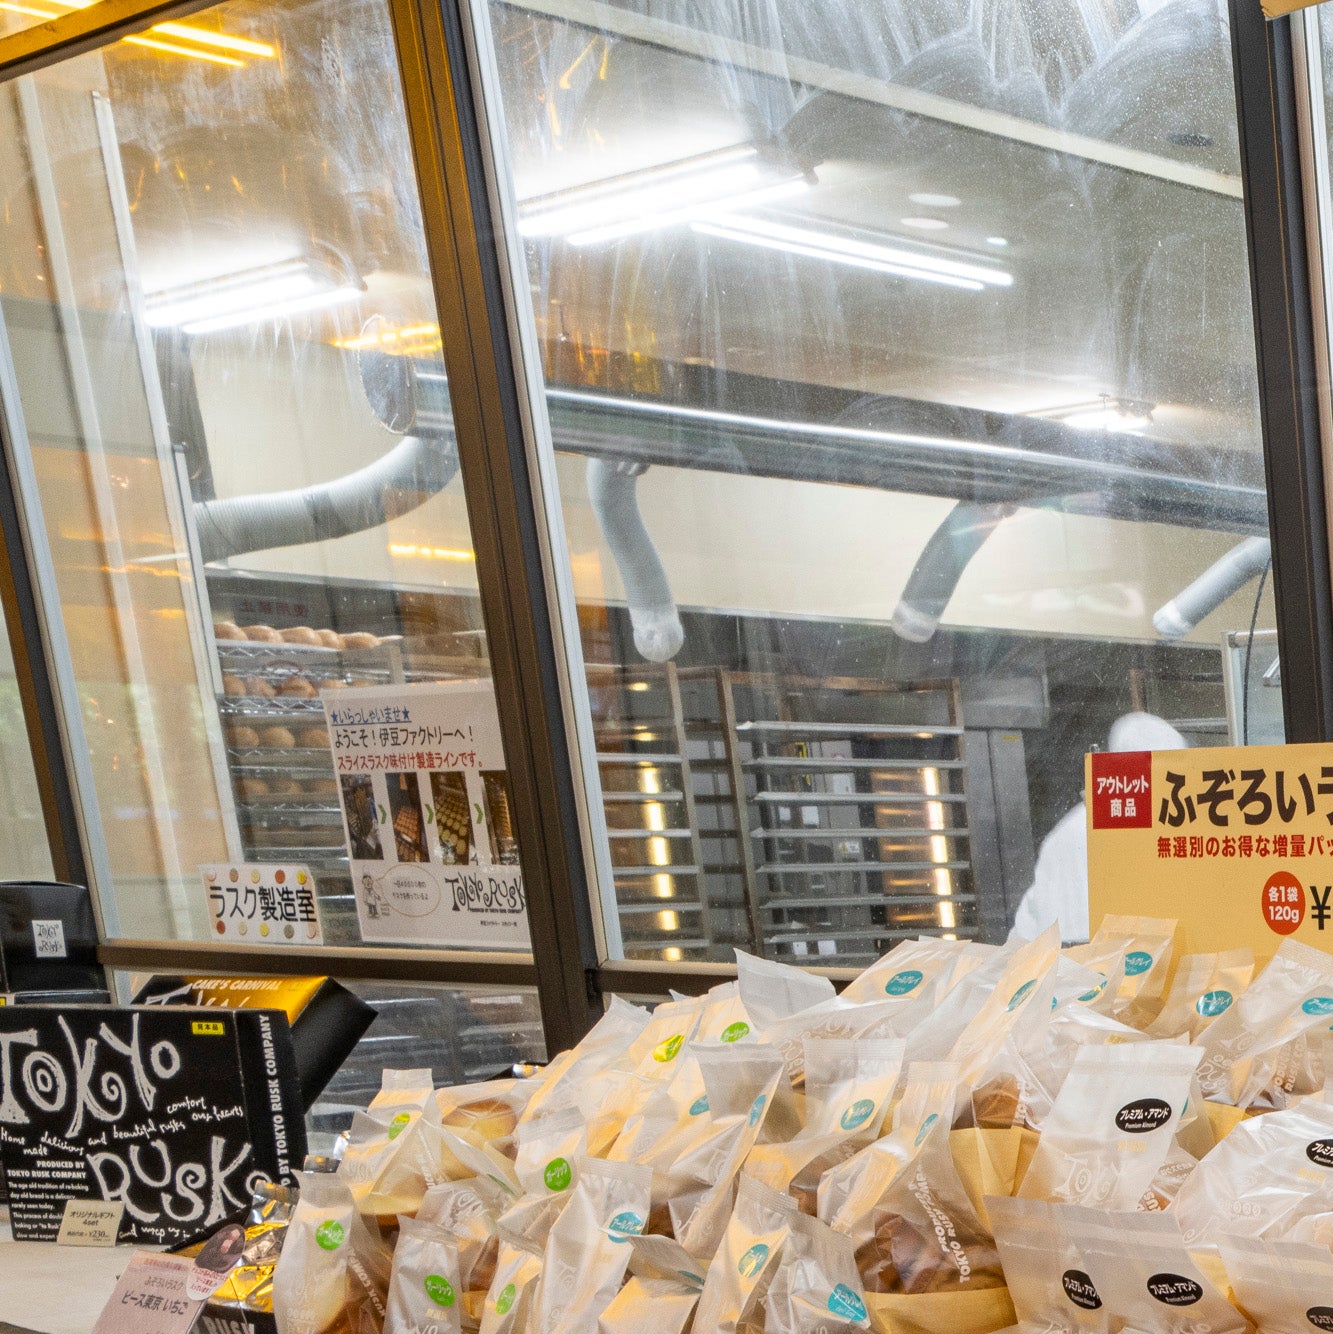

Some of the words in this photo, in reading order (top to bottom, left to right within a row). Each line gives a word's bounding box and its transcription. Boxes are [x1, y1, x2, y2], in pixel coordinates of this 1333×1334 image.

[1097, 775, 1148, 794] アウトレット
[1110, 798, 1137, 817] 商品
[210, 887, 316, 922] ラスク製造室
[1268, 886, 1298, 902] 各1袋
[1269, 906, 1299, 923] 120g
[259, 1014, 279, 1076] COMPANY
[0, 1012, 181, 1138] TOKYO
[269, 1078, 283, 1114] RUSK
[272, 1117, 288, 1155] TOKYO
[32, 1170, 50, 1178] RUSK
[87, 1137, 271, 1226] RUSK
